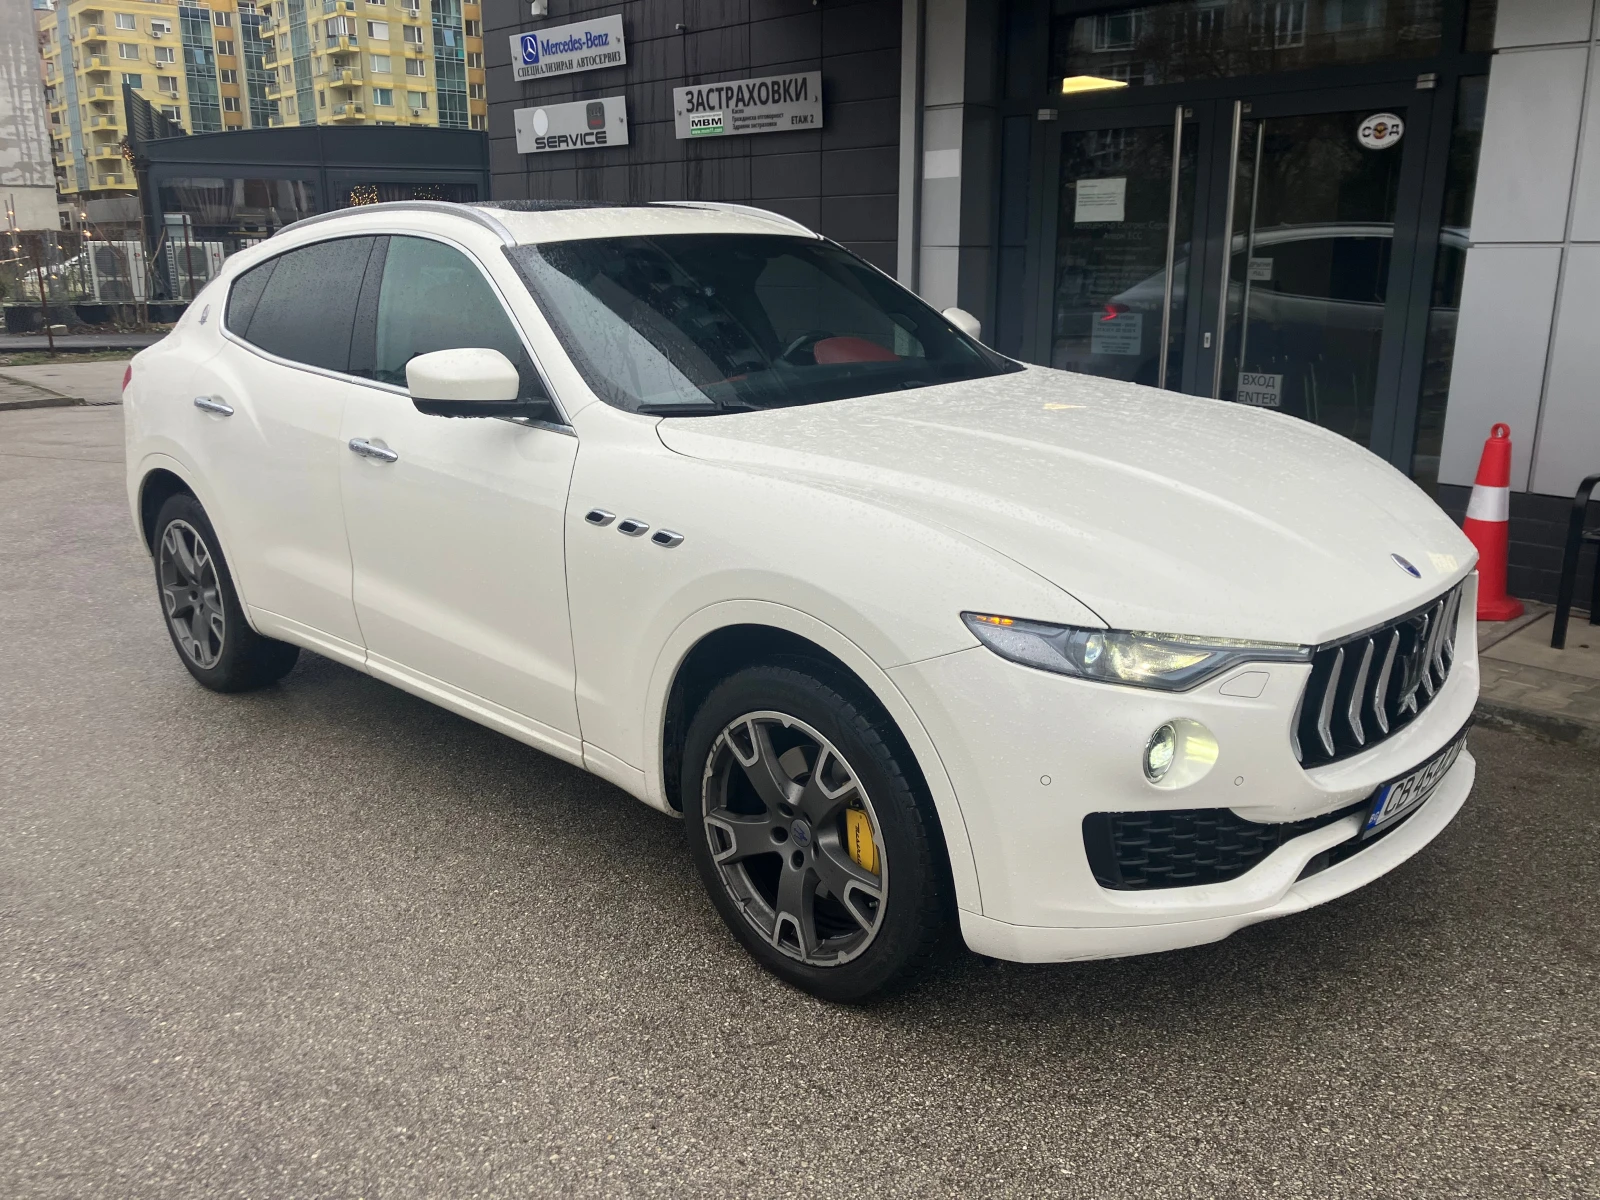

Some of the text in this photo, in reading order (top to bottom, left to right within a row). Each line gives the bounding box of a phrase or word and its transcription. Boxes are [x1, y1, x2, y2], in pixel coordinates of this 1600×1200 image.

[540, 31, 610, 57] Mercedes-Benz
[517, 50, 622, 78] СПЕЦИАЛИЗИРАН АВТОСЕРВИЗ
[685, 77, 808, 113] ЗАСТРАХОВКИ
[791, 114, 815, 125] ЕТАЖ 2
[534, 130, 608, 150] SERVICE
[1242, 374, 1276, 390] ВХОД
[1237, 390, 1278, 405] ENTER
[1384, 774, 1416, 816] CB
